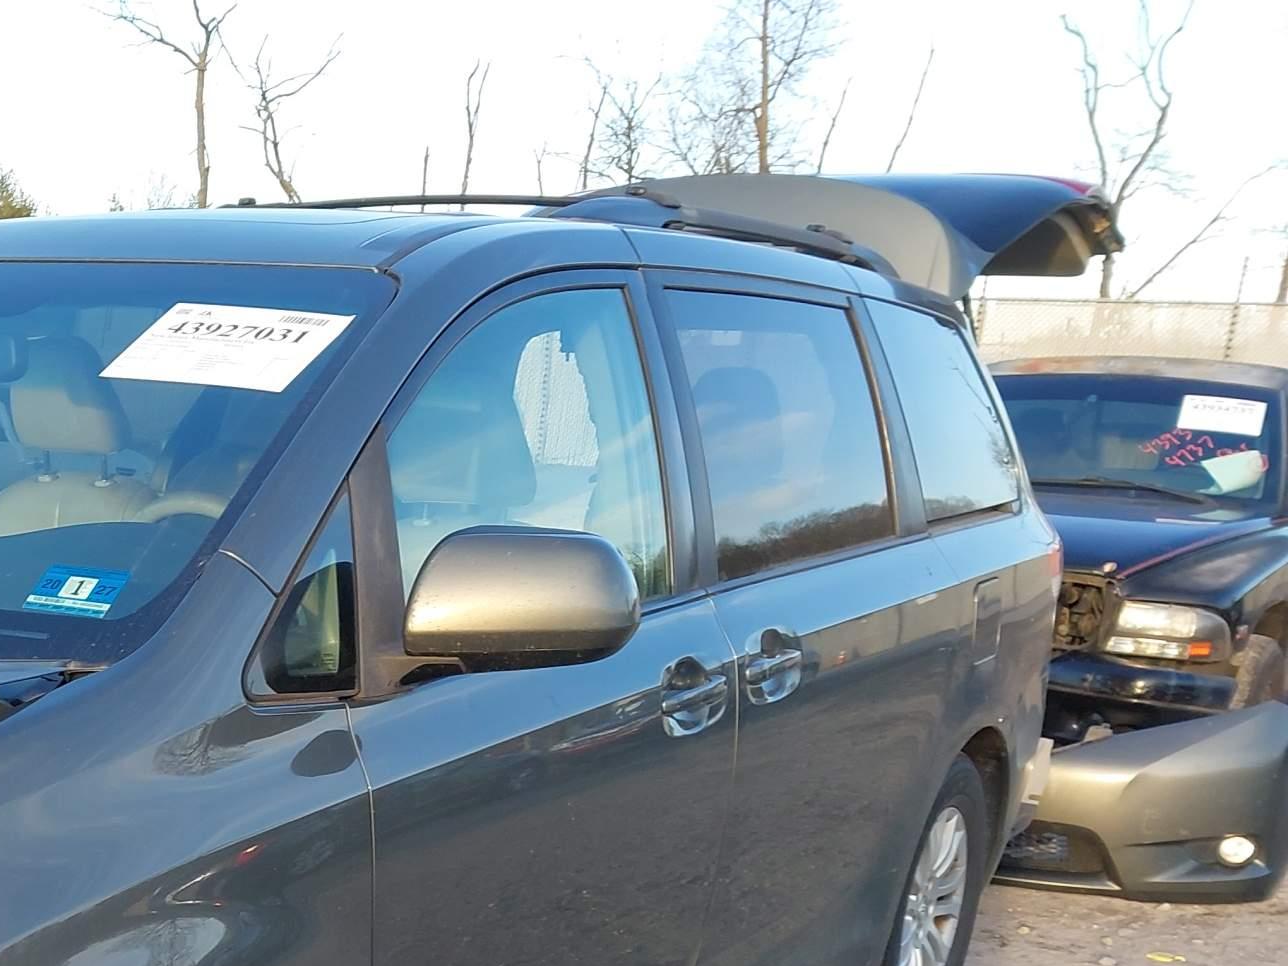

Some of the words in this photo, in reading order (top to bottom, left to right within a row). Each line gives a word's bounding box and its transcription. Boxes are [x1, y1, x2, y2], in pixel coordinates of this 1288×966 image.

[167, 320, 310, 345] 43927031
[41, 578, 63, 590] 20
[70, 579, 85, 596] 1
[94, 585, 117, 597] 27
